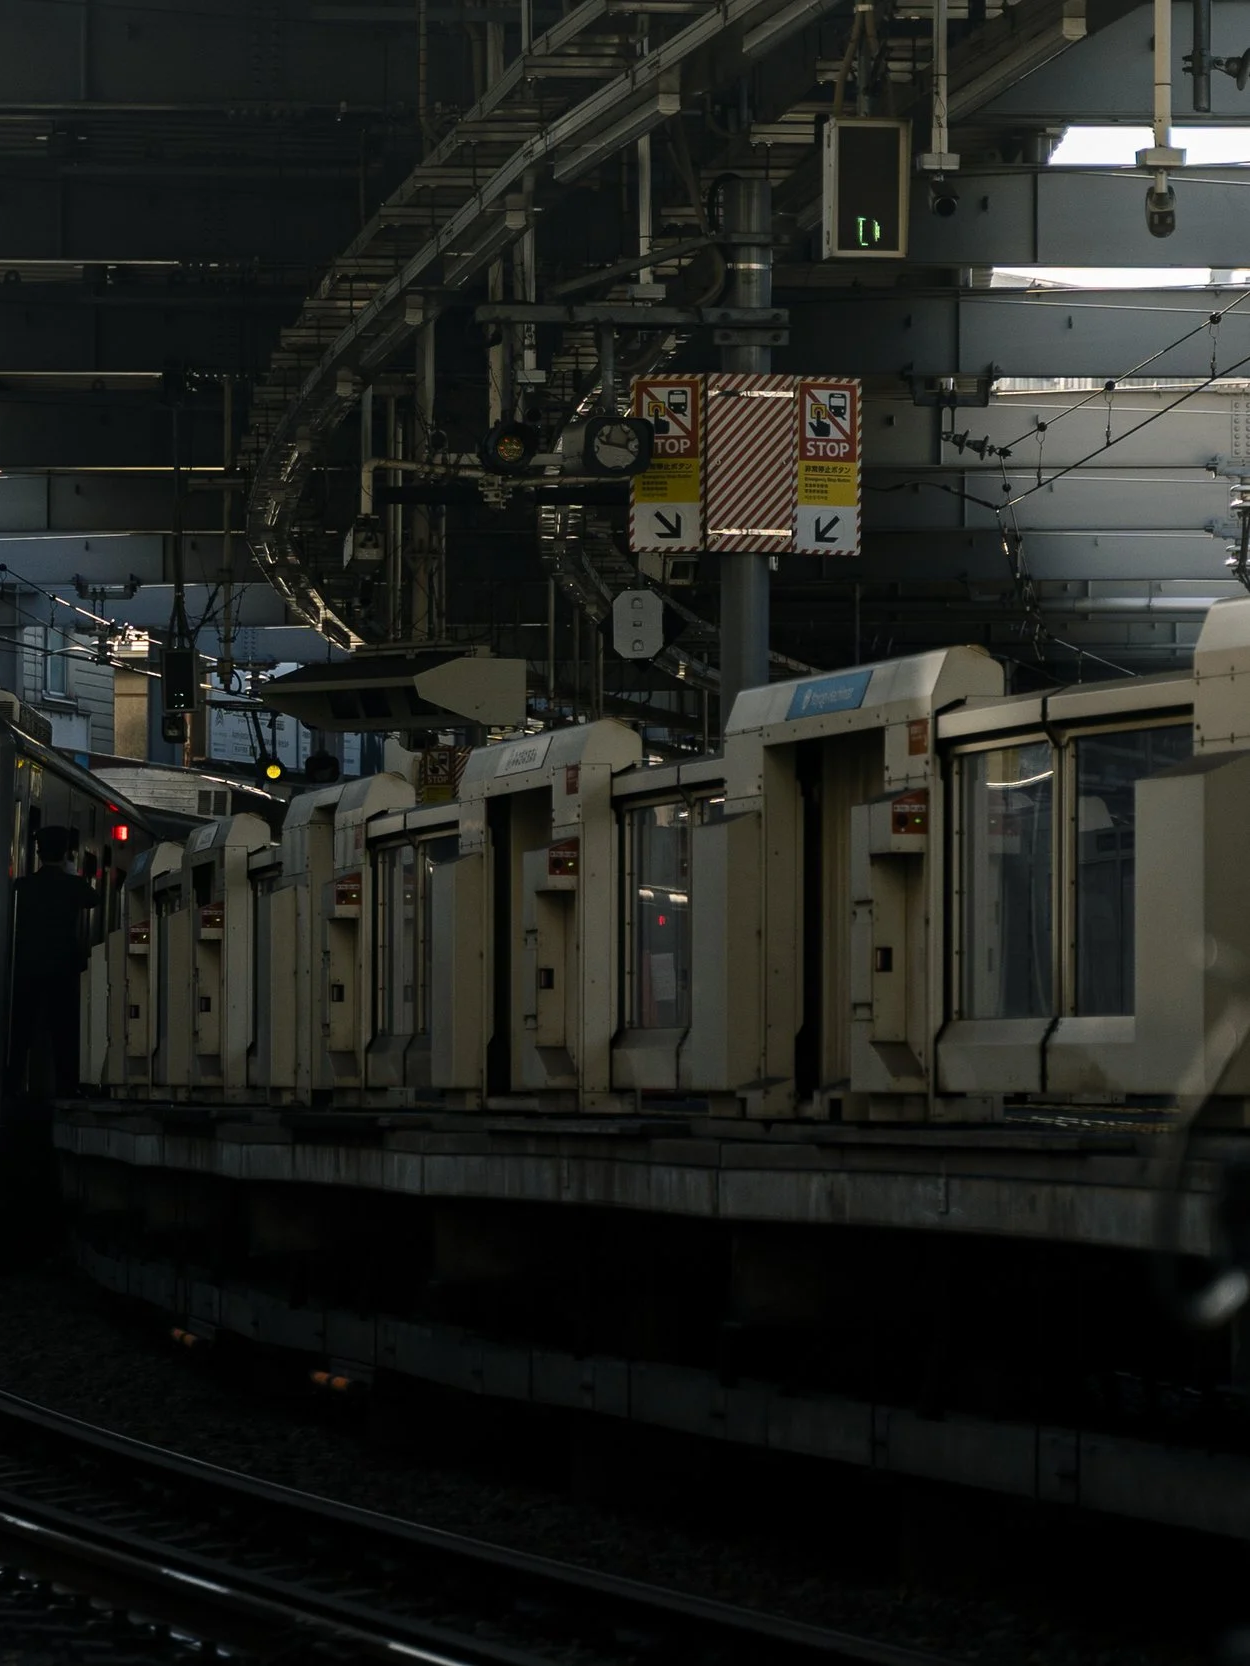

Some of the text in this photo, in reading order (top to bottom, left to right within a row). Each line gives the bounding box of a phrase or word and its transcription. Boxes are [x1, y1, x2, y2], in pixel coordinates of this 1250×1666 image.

[654, 438, 691, 454] TOP
[806, 441, 850, 457] STOP
[649, 462, 693, 471] 常停止ボタン
[805, 464, 851, 474] 非常停止ボタン
[427, 775, 449, 784] STOP
